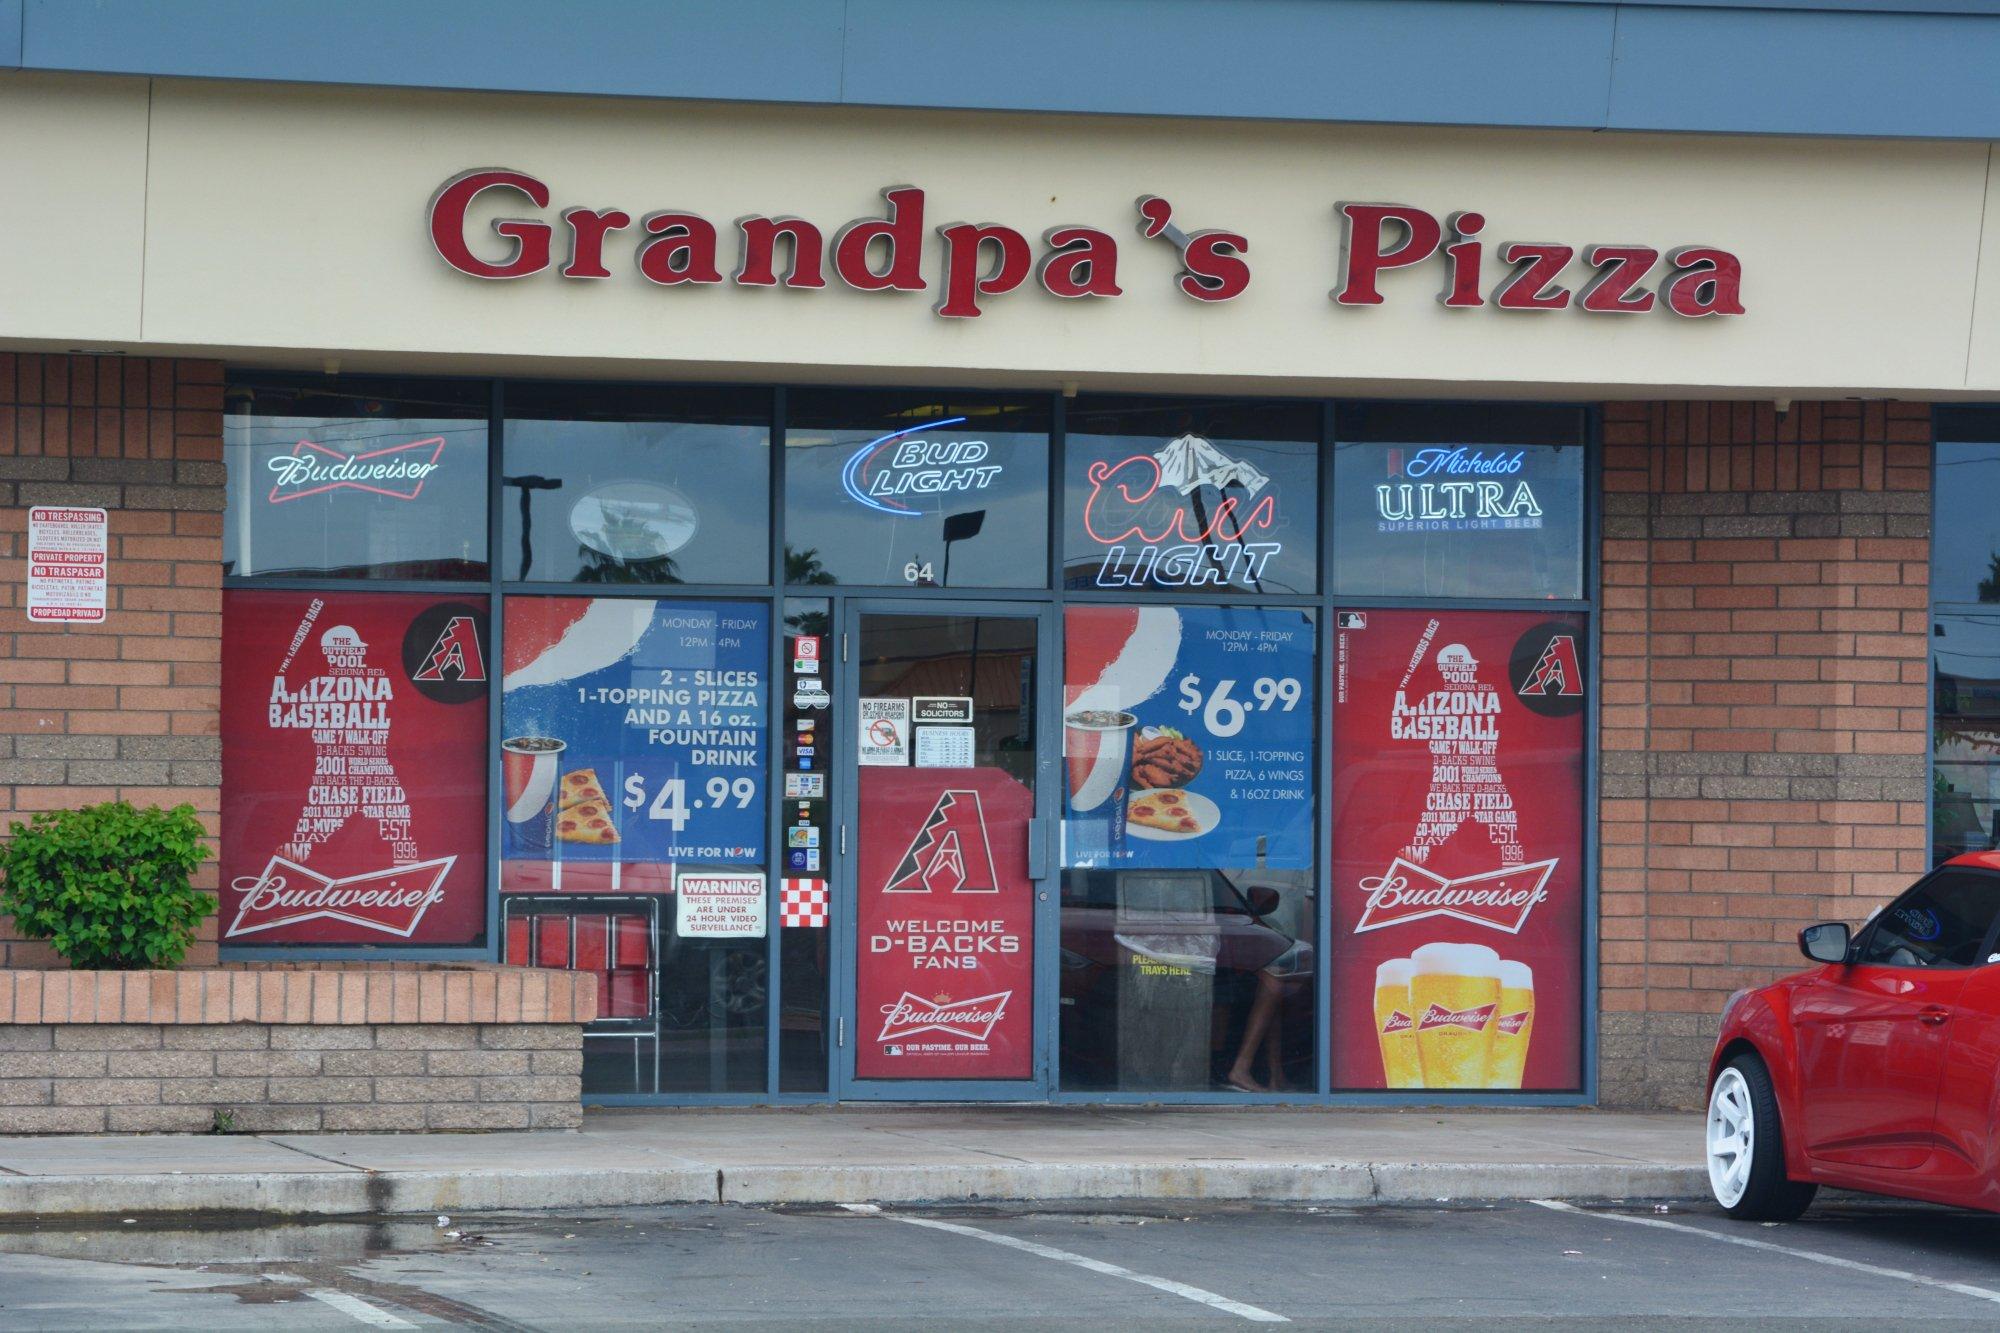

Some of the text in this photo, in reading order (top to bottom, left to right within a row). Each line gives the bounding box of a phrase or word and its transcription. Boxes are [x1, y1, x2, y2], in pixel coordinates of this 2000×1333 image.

[425, 166, 1747, 319] Grandpa's Pizza
[892, 441, 988, 468] BUD
[1407, 447, 1524, 477] Michelob
[267, 455, 438, 486] Budweiser
[869, 465, 1002, 496] LIGHT
[1377, 481, 1542, 520] ULTRA
[35, 511, 102, 521] NO TRESPASSING
[1378, 518, 1541, 531] SUPERIOR LIGHT BEER
[34, 553, 102, 562] PRIVATE PROPERTY
[34, 567, 102, 577] NO TRASPASAR
[904, 562, 934, 581] 64
[1096, 543, 1281, 587] LIGHT
[33, 608, 101, 617] PROPIEDAD PRIVADA
[288, 619, 312, 657] LEGENDS
[305, 598, 324, 621] RACE
[662, 618, 758, 629] MONDAY FRIDAY
[680, 637, 740, 648] 12PM 4PM
[1206, 630, 1293, 641] MONDAY FRIDAY
[322, 647, 366, 655] OUTFIELD
[1222, 642, 1278, 653] 12PM 4PM
[1407, 638, 1430, 674] LEGENDS
[1422, 618, 1440, 641] RACE
[327, 655, 366, 667] POOL
[329, 668, 364, 676] SEDONA
[661, 670, 672, 685] 2
[694, 670, 758, 687] SLICES
[1442, 672, 1478, 683] POOL
[578, 687, 758, 707] 1-TOPPING PIZZA
[863, 702, 905, 711] NO FIREARMS
[1178, 673, 1301, 737] $6.99
[269, 703, 391, 729] BASEBALL
[624, 709, 757, 727] AND A 16 oz.
[1391, 715, 1499, 740] BASEBALL
[312, 730, 389, 744] GAME 7 WALK-OFF
[649, 729, 756, 746] FOUNTAIN
[316, 745, 387, 756] D-BACKS SWING
[1429, 741, 1498, 755] GAME 7 WALK-OFF
[692, 749, 757, 766] DRINK
[1207, 751, 1304, 763] 1 SLICE, 1-TOPPING
[1433, 755, 1495, 766] D-BACKS SWING
[315, 756, 347, 775] 2001
[348, 765, 394, 775] CHAMPIONS
[312, 776, 399, 786] WE BACK THE D-BACKS
[1225, 770, 1304, 781] PIZZA, 6 WINGS
[1432, 766, 1460, 783] 2001
[1461, 774, 1502, 783] CHAMPIONS
[309, 785, 406, 805] CHASE FIELD
[1230, 789, 1238, 799] &
[1269, 789, 1304, 800] DRINK
[1430, 783, 1507, 793] WE BACK THE D-BACKS
[623, 772, 755, 831] $4.99
[1426, 792, 1513, 810] CHASE FIELD
[303, 805, 411, 818] 2011 MLB GAME
[1421, 811, 1518, 824] 2011 MLB GAME
[379, 819, 412, 840] EST.
[1488, 824, 1519, 844] EST.
[293, 833, 333, 843] DAY
[1412, 836, 1449, 846] DAY
[392, 842, 417, 859] 1998
[668, 847, 694, 857] LIVE
[697, 847, 721, 857] FOR
[1500, 845, 1523, 861] 1998
[231, 876, 444, 911] Budweiser
[684, 880, 760, 894] WARNING
[1359, 877, 1547, 910] Budweiser
[731, 915, 758, 923] VIDEO
[886, 920, 1004, 933] WELCOME
[870, 935, 1020, 953] D-BACKS
[913, 955, 977, 969] FANS
[1141, 965, 1168, 975] TRAYS
[880, 1004, 1006, 1025] Budweiser
[1420, 1009, 1494, 1024] Budweiser
